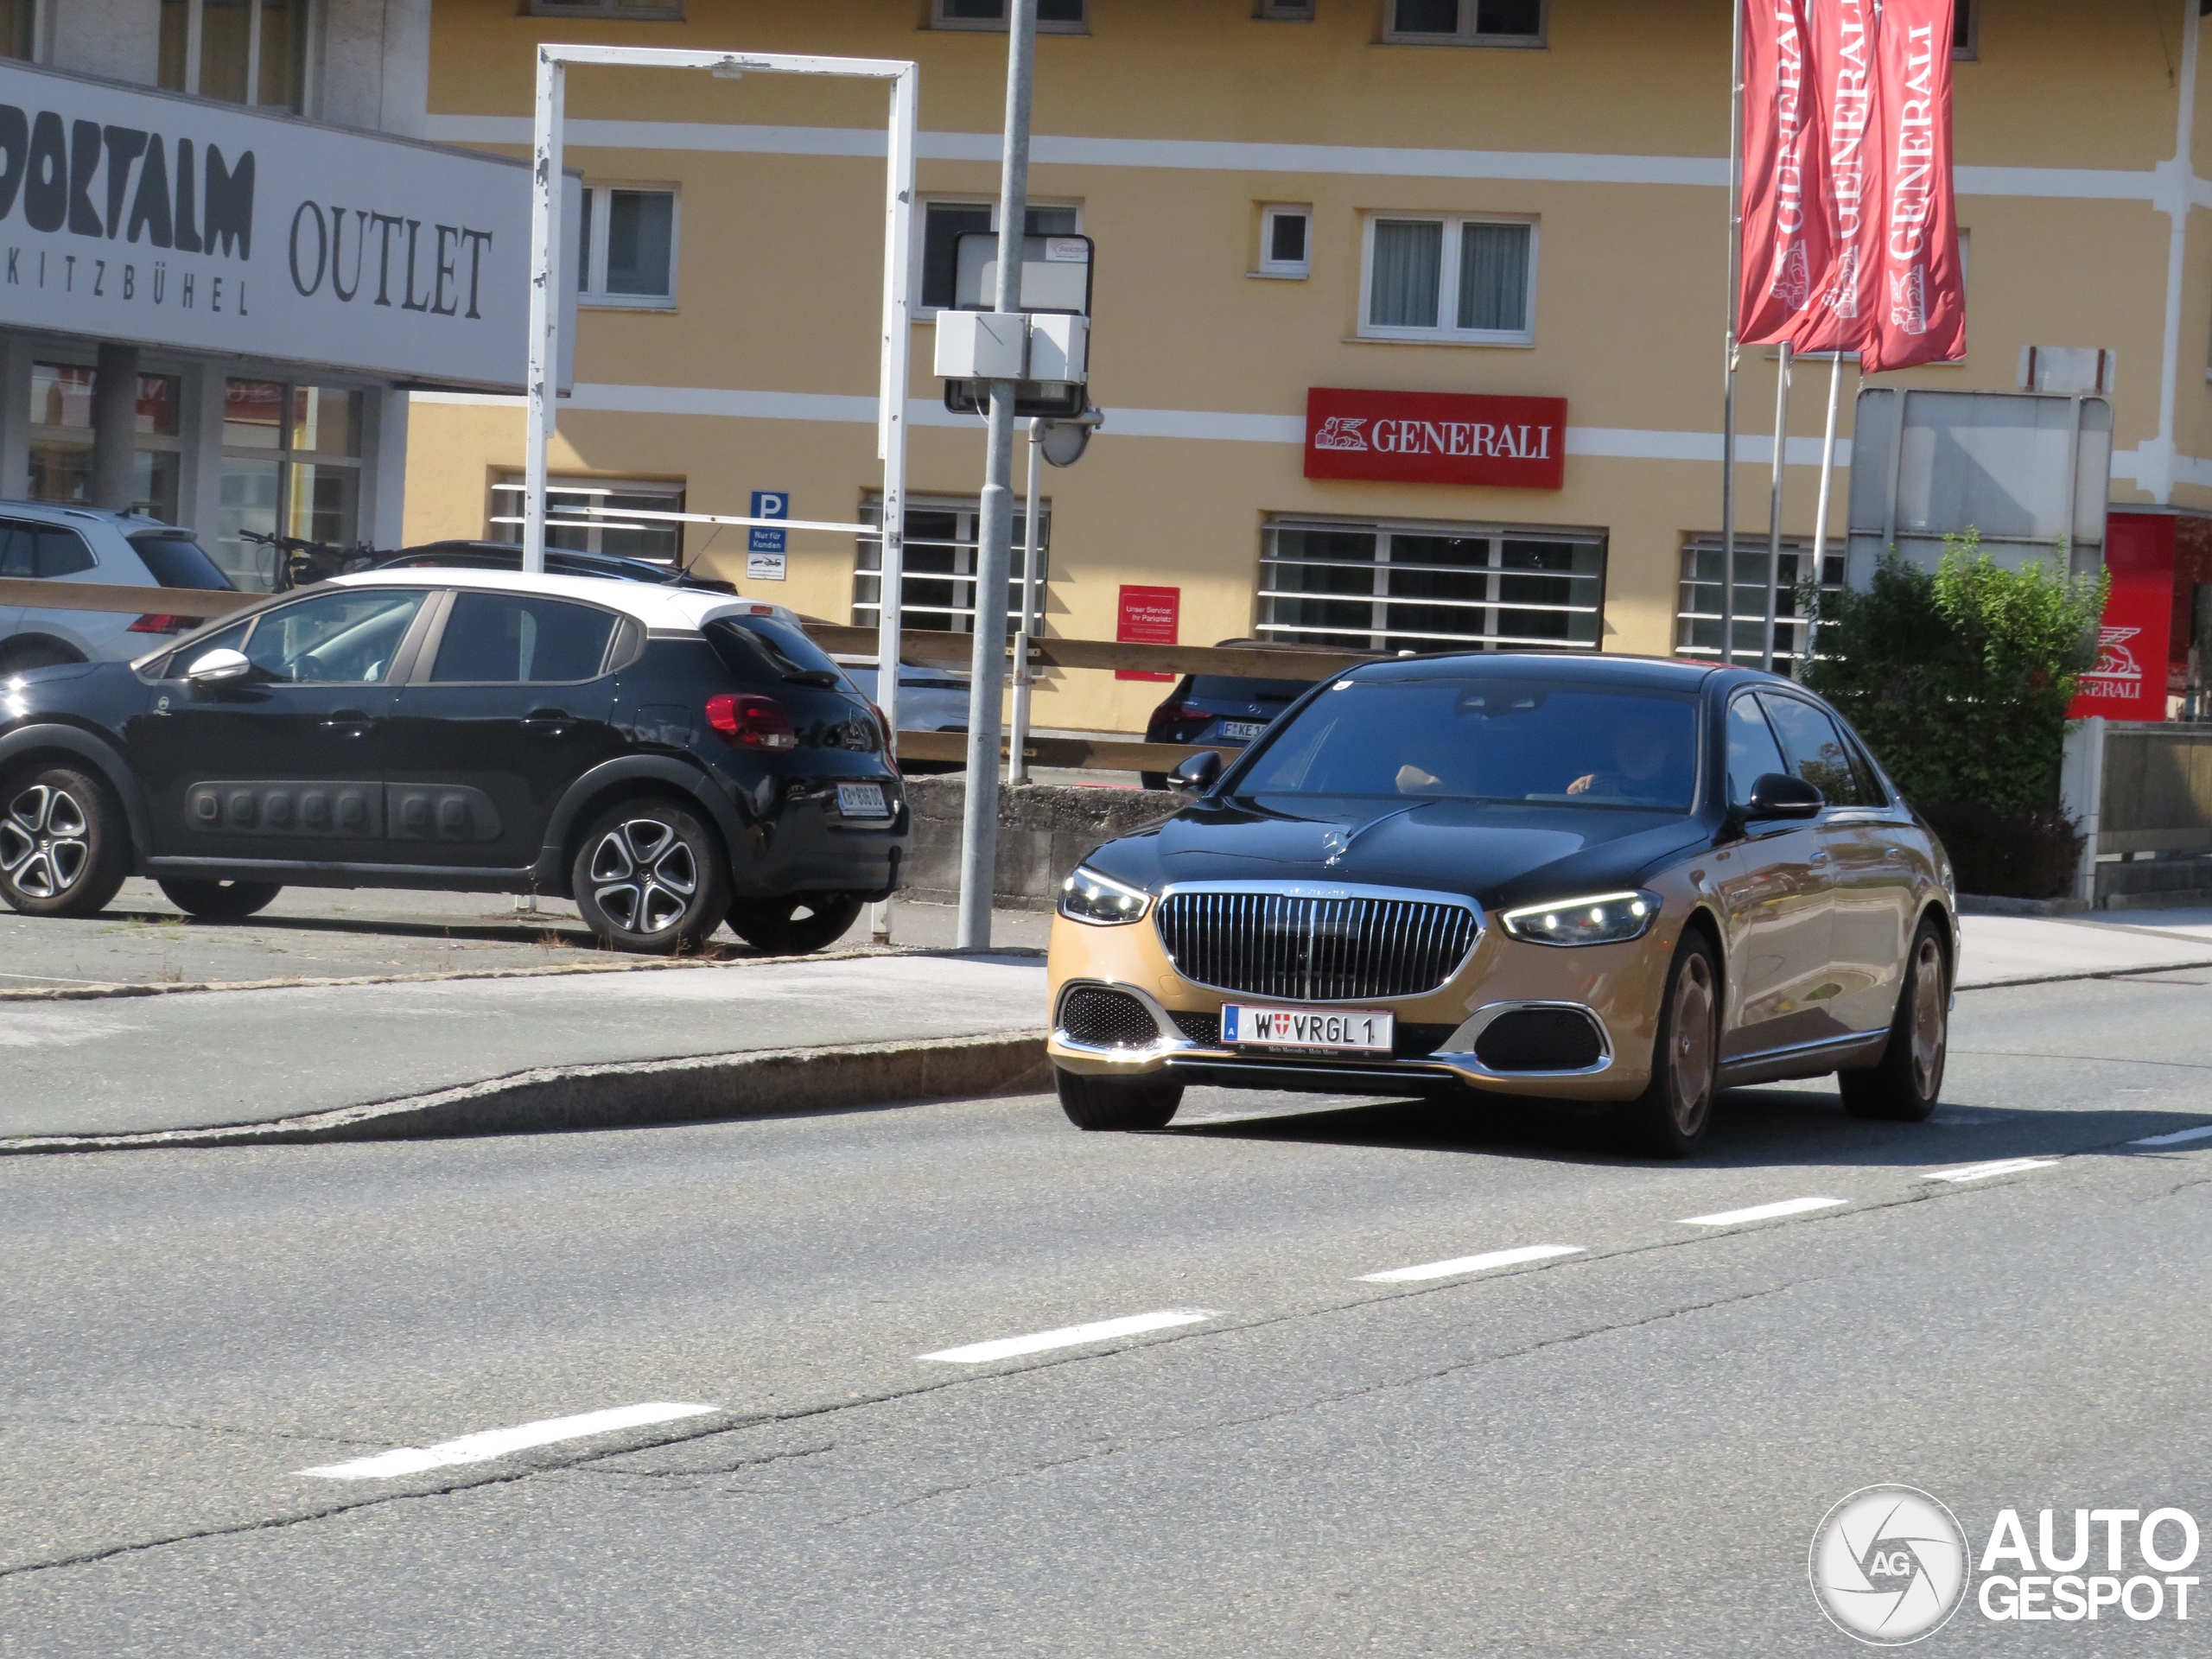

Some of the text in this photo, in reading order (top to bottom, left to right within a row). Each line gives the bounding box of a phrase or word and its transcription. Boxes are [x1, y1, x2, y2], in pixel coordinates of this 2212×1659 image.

[1889, 21, 1934, 262] GENERALI
[289, 200, 493, 321] OUTLET
[8, 245, 249, 316] KITZBÜHEL
[1371, 419, 1552, 460] GENERALI
[760, 494, 782, 519] P
[753, 540, 781, 550] Kunden
[754, 531, 781, 540] Nur für
[1141, 614, 1172, 623] Parkplatz
[1228, 1027, 1235, 1036] A
[1255, 1012, 1373, 1044] W VRGL 1
